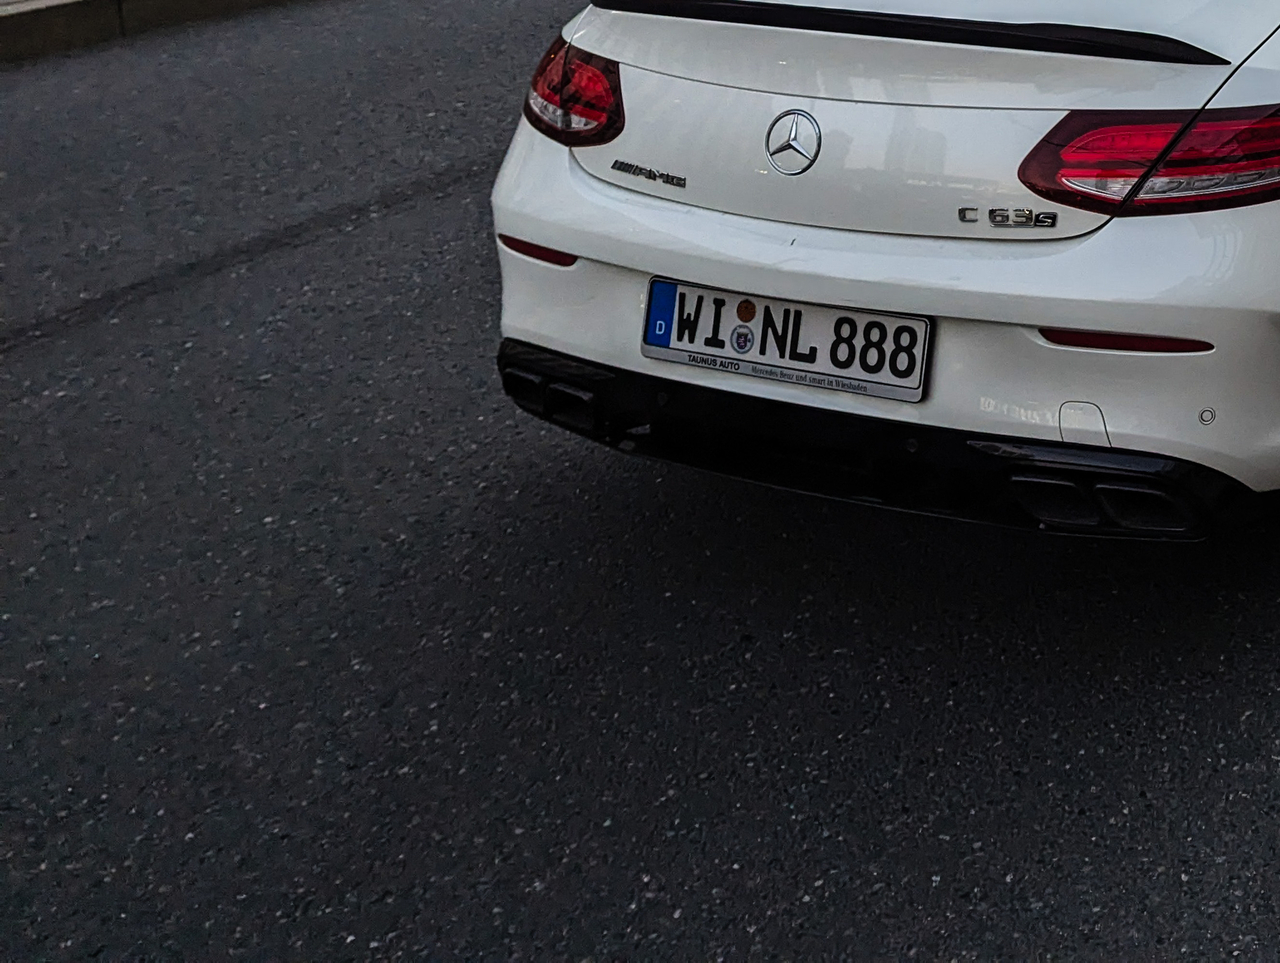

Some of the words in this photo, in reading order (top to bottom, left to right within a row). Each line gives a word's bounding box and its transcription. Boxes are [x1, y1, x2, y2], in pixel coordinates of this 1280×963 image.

[958, 206, 979, 223] C
[655, 319, 666, 336] D
[675, 291, 727, 350] WI
[759, 308, 818, 365] NL
[829, 316, 919, 380] 888
[688, 354, 718, 367] TAUNUS
[718, 359, 741, 371] AUTO
[795, 374, 808, 383] und
[808, 376, 826, 387] smart
[826, 378, 834, 387] in
[834, 379, 869, 392] Wiesbaden
